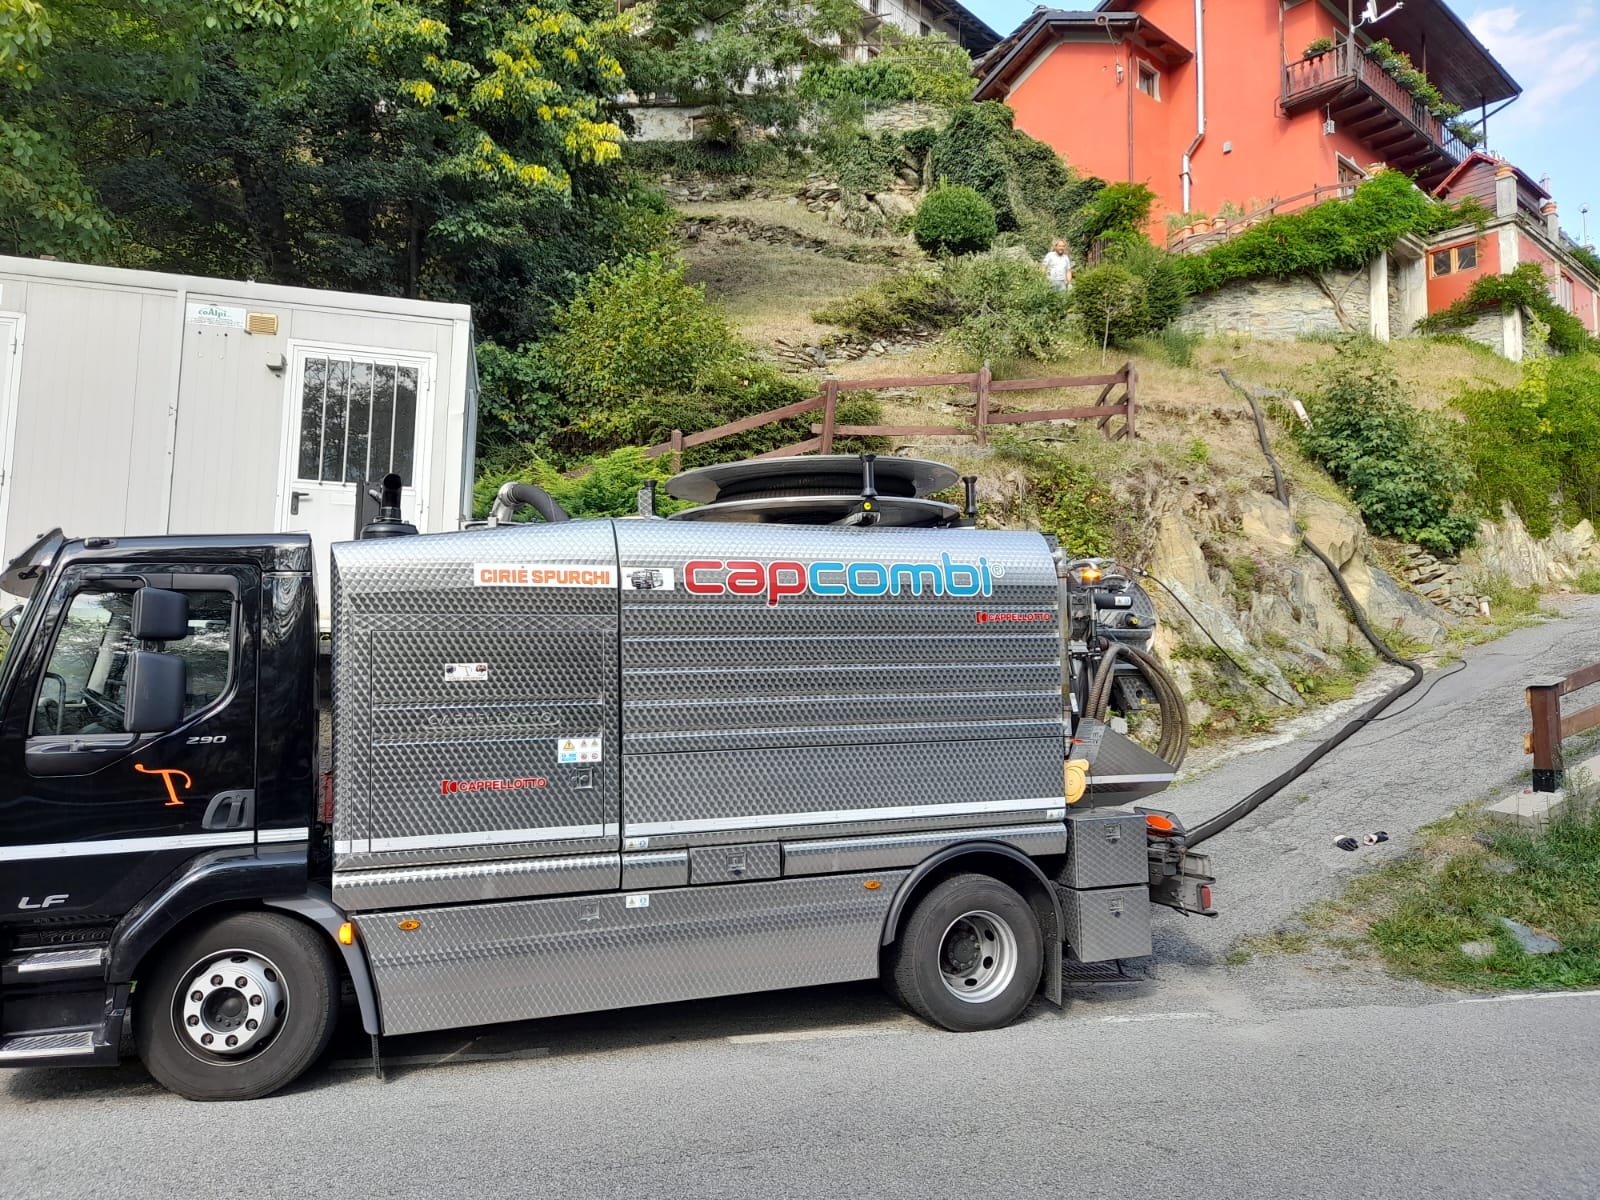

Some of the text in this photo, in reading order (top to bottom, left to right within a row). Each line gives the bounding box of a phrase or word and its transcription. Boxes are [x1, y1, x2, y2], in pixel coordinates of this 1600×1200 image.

[531, 569, 610, 586] SPURGHI
[988, 612, 1052, 623] CAPPELLOTTO
[186, 735, 228, 745] 290
[459, 777, 547, 792] CAPPELLOTTO
[17, 893, 70, 910] LF
